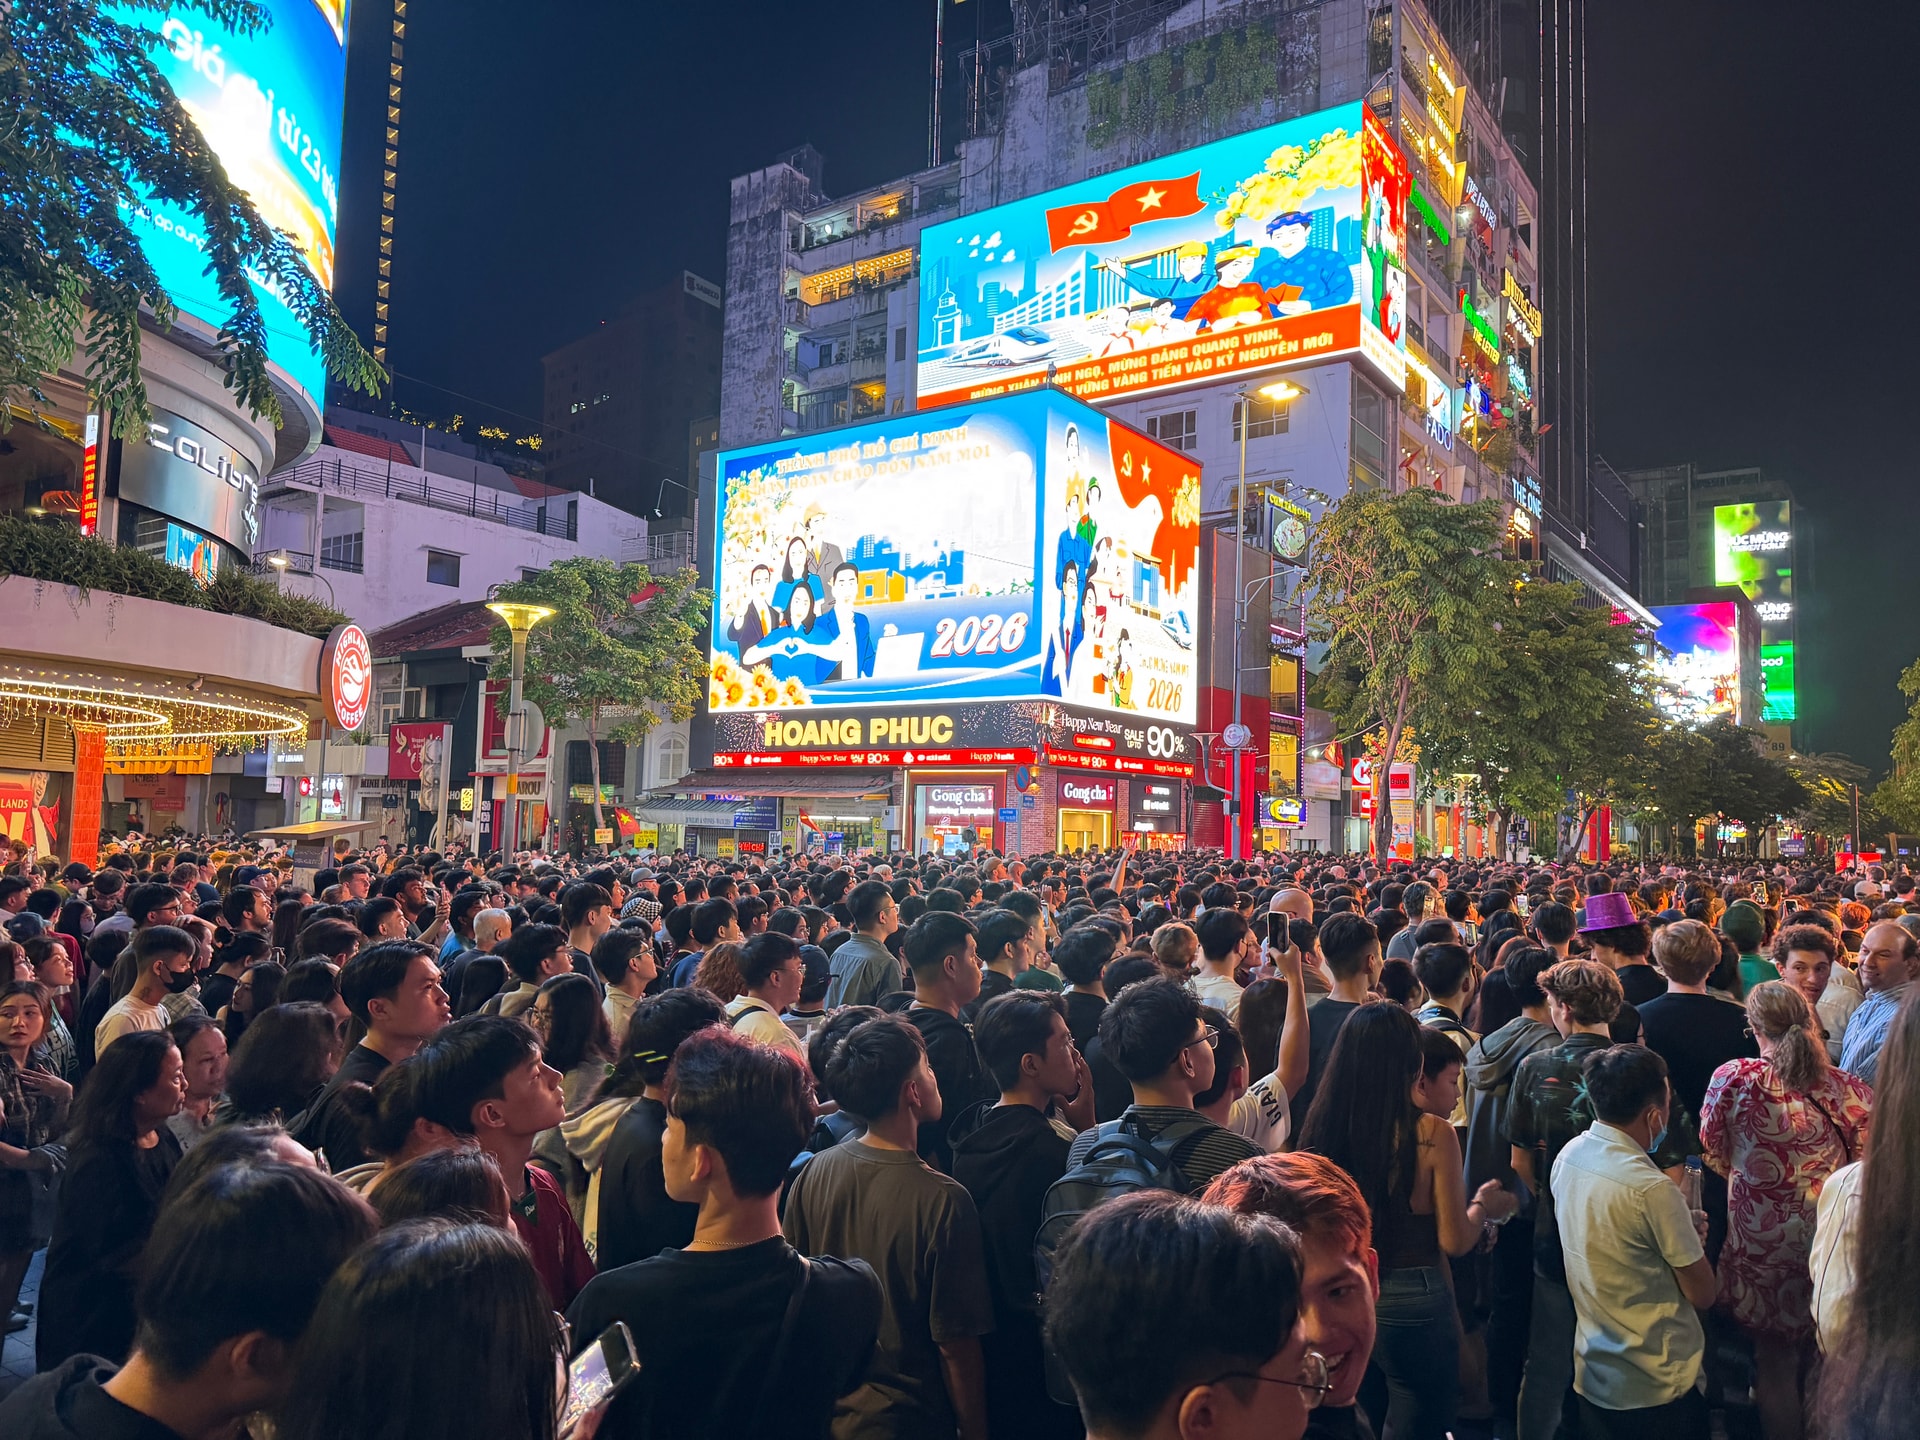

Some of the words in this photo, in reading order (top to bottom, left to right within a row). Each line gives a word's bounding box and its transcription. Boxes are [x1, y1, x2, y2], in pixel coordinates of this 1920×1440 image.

[300, 134, 321, 182] 23
[1108, 357, 1148, 374] MỪNG
[1192, 336, 1239, 357] QUANG
[1243, 327, 1283, 346] VINH,
[1113, 371, 1148, 391] VÀNG
[1185, 357, 1213, 375] VÀO
[1239, 340, 1299, 364] NGUYÊN
[1303, 331, 1334, 351] MỚI
[1481, 338, 1500, 366] LETTER
[921, 426, 969, 449] MINH
[1426, 414, 1453, 452] FADO
[1511, 477, 1527, 508] THE
[1527, 492, 1542, 520] ONE
[930, 613, 1029, 658] 2026
[336, 631, 371, 678] HIGHLANDS
[1146, 678, 1183, 713] 2026
[337, 699, 364, 726] COFFEE
[1061, 713, 1088, 733] Happy
[1087, 717, 1105, 731] New
[1105, 719, 1123, 734] Year
[764, 720, 862, 746] HOANG
[869, 715, 953, 744] PHUC
[1124, 729, 1145, 742] SALE
[1147, 725, 1185, 759] 90%
[713, 754, 734, 765] 90%
[800, 755, 819, 764] Happy
[867, 753, 890, 764] 90%
[1772, 742, 1785, 752] 89
[360, 778, 380, 788] MINH
[931, 788, 963, 805] Gong
[964, 789, 985, 801] cha
[1063, 782, 1090, 804] Gong
[1090, 784, 1107, 801] cha
[785, 818, 796, 827] 97
